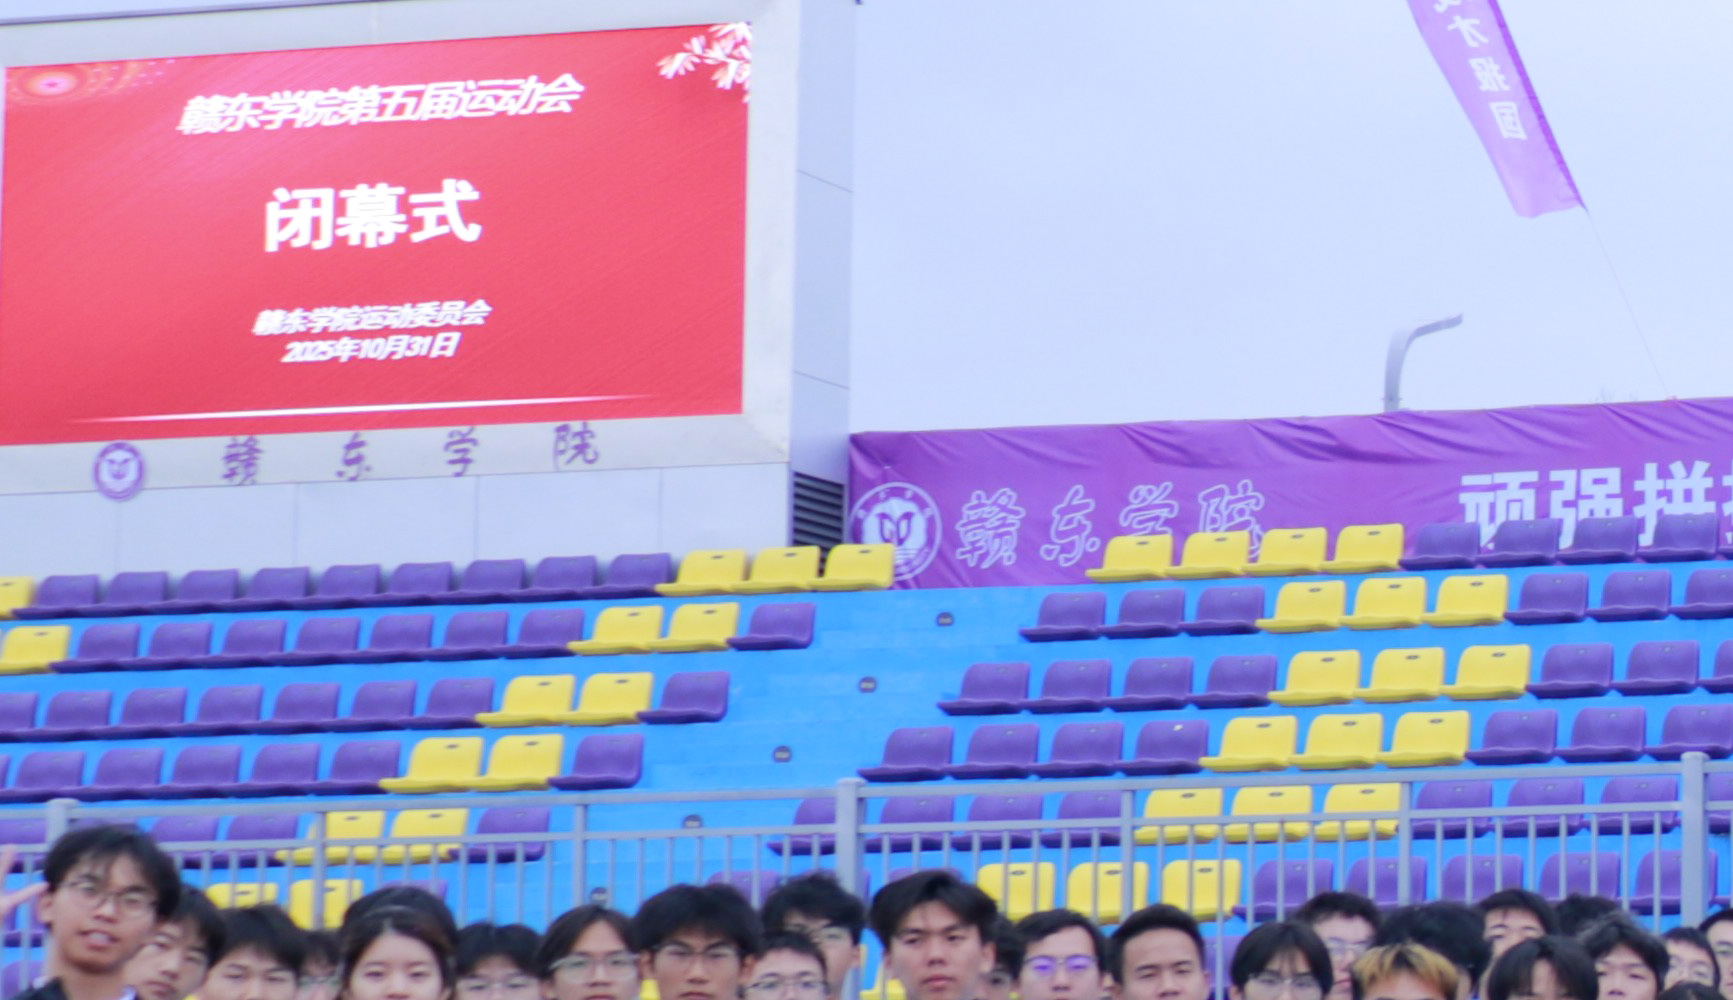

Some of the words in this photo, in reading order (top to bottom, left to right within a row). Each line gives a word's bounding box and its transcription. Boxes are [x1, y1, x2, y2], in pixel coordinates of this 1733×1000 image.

[176, 73, 584, 135] 赣东学院第五届运动会
[264, 178, 483, 252] 闭幕式
[251, 298, 493, 336] 赣东学院运动委员会
[280, 331, 462, 363] 2025年10月31日
[221, 420, 600, 487] 赣东学院
